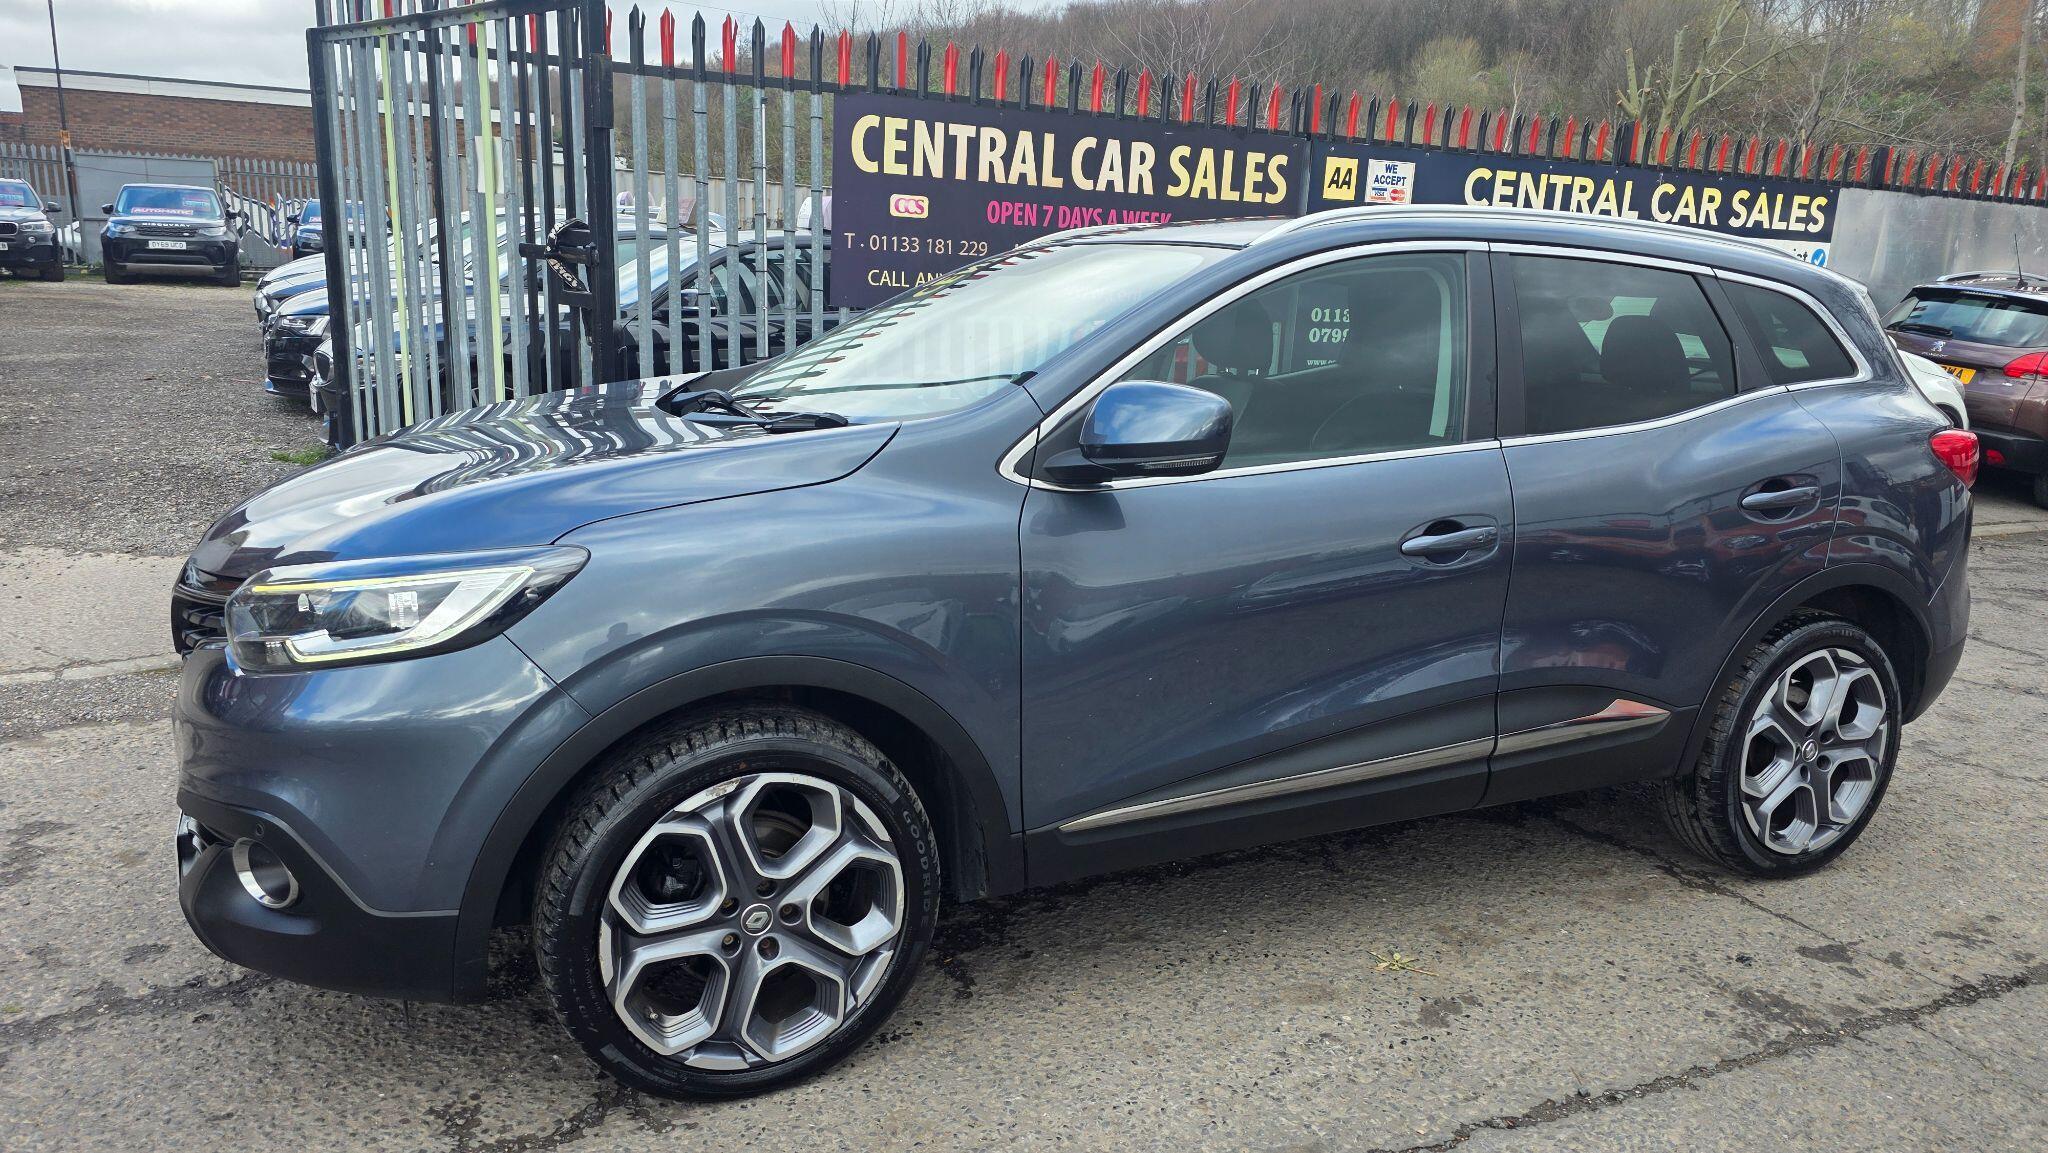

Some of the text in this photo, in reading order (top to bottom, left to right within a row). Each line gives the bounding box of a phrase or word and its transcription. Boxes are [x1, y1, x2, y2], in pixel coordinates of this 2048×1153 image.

[851, 114, 1289, 204] CENTRAL CAR SALES
[1385, 163, 1398, 174] WE
[1327, 167, 1353, 190] AA
[1373, 174, 1407, 187] ACCEPT
[1464, 167, 1828, 233] CENTRAL CAR SALES
[986, 200, 1038, 227] OPEN
[1042, 205, 1055, 228] 7
[1058, 206, 1103, 229] DAYS
[869, 234, 920, 253] 01133
[926, 238, 952, 255] 181
[958, 240, 988, 257] 229
[867, 269, 910, 288] CALL
